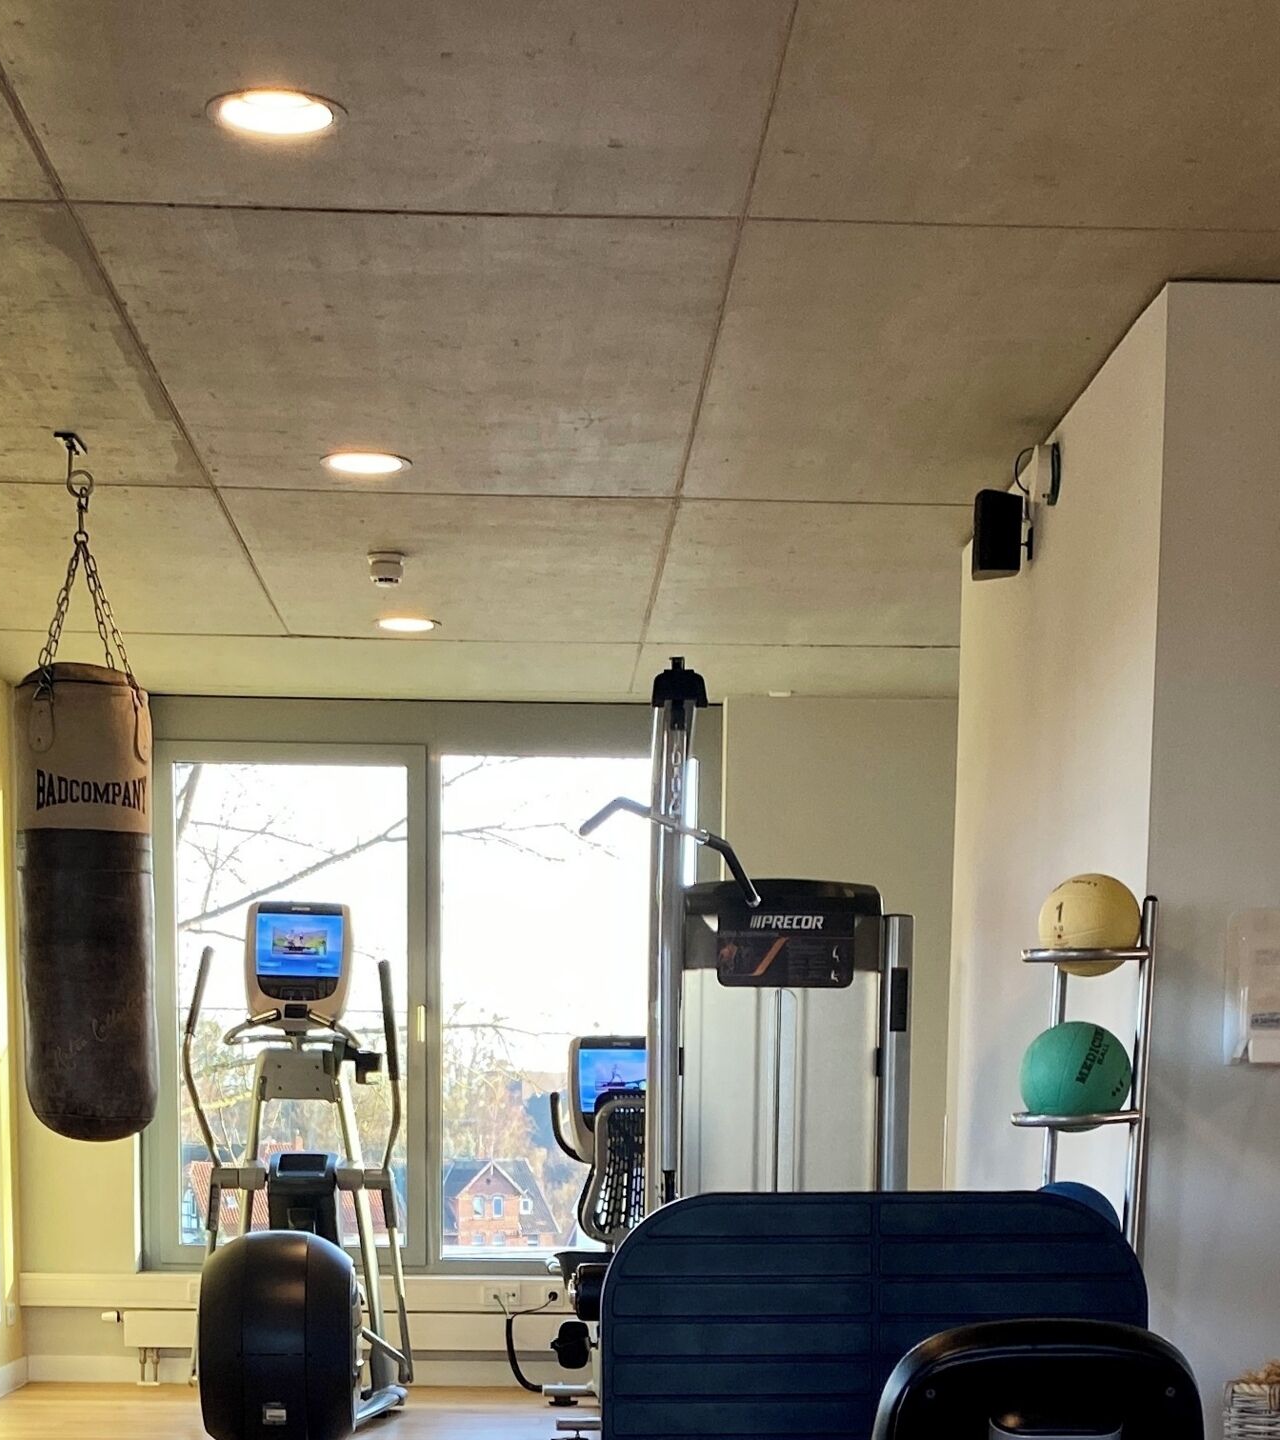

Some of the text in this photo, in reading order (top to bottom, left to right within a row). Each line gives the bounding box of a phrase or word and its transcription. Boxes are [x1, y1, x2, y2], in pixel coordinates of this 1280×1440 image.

[36, 768, 147, 814] BADCOMPANY
[752, 914, 824, 930] PRECOR
[1055, 902, 1064, 923] 1
